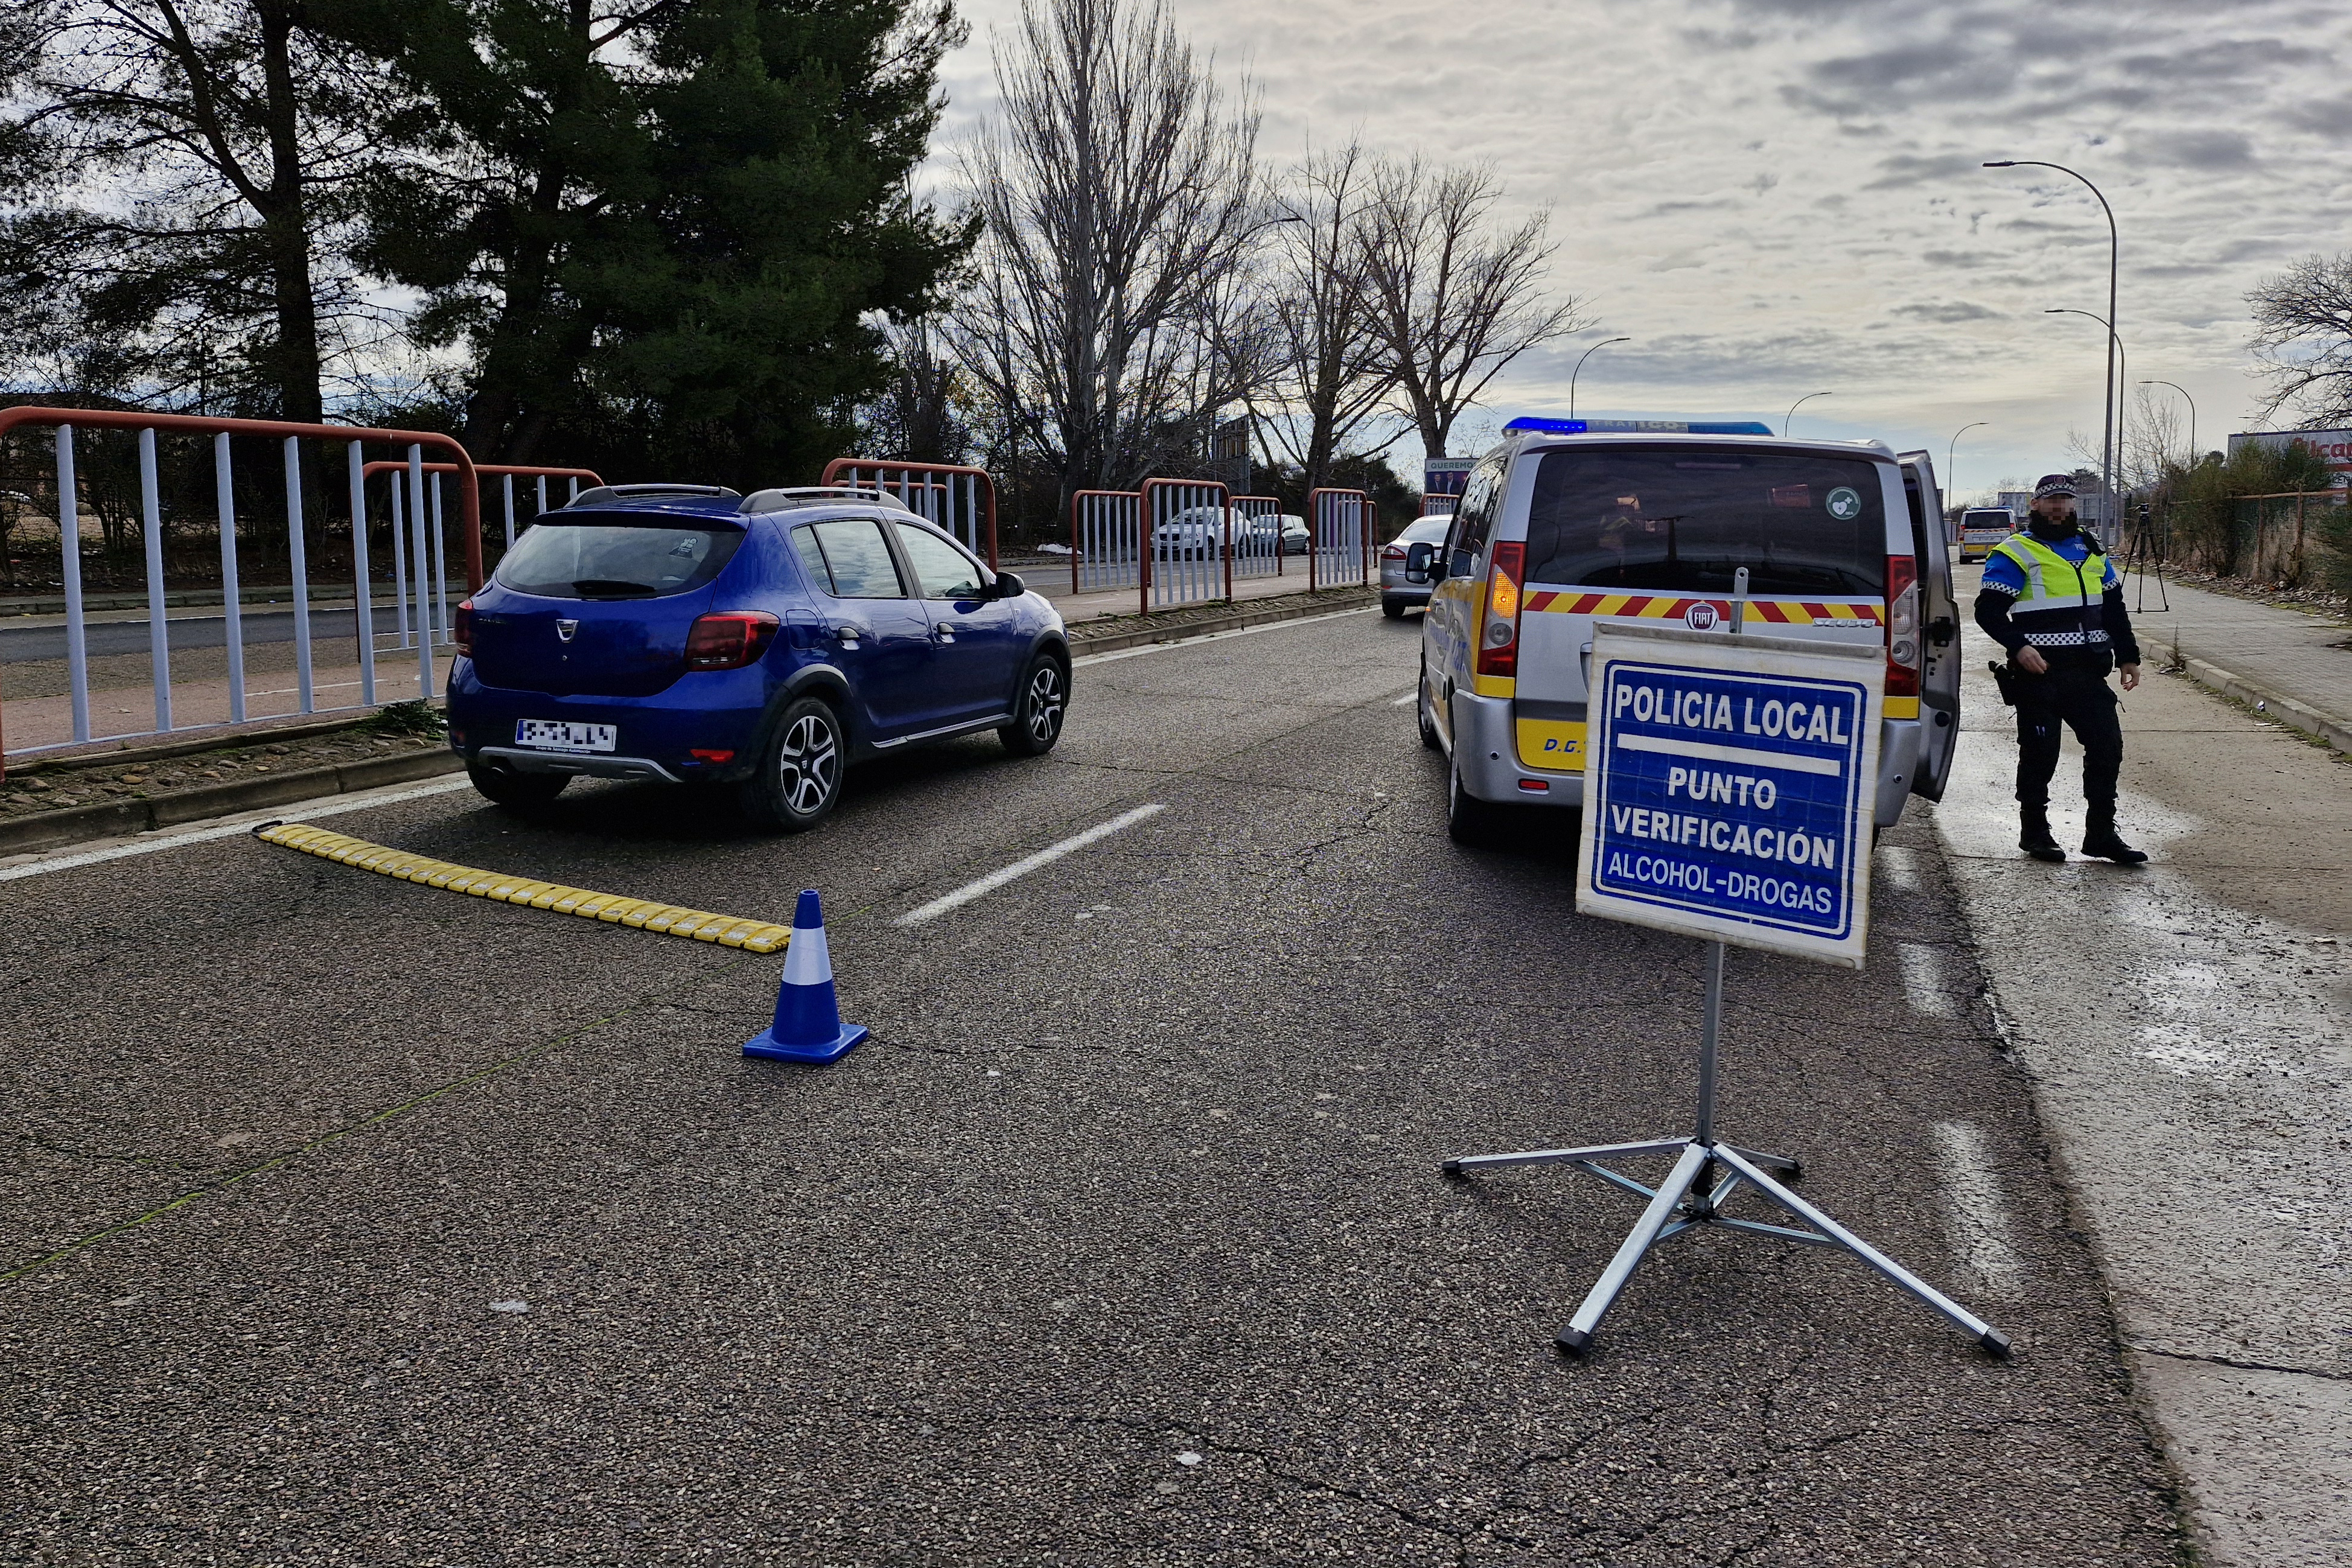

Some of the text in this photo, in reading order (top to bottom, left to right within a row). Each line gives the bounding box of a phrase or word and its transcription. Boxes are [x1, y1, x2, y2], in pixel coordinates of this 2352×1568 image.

[1694, 612, 1712, 625] FIAT
[1614, 684, 1849, 745] POLICIA LOCAL
[1544, 739, 1586, 753] D.G.
[1668, 766, 1777, 810] PUNTO
[1611, 805, 1835, 870] VERIFICACIÓN
[1608, 852, 1832, 914] ALCOHOL-DROGAS
